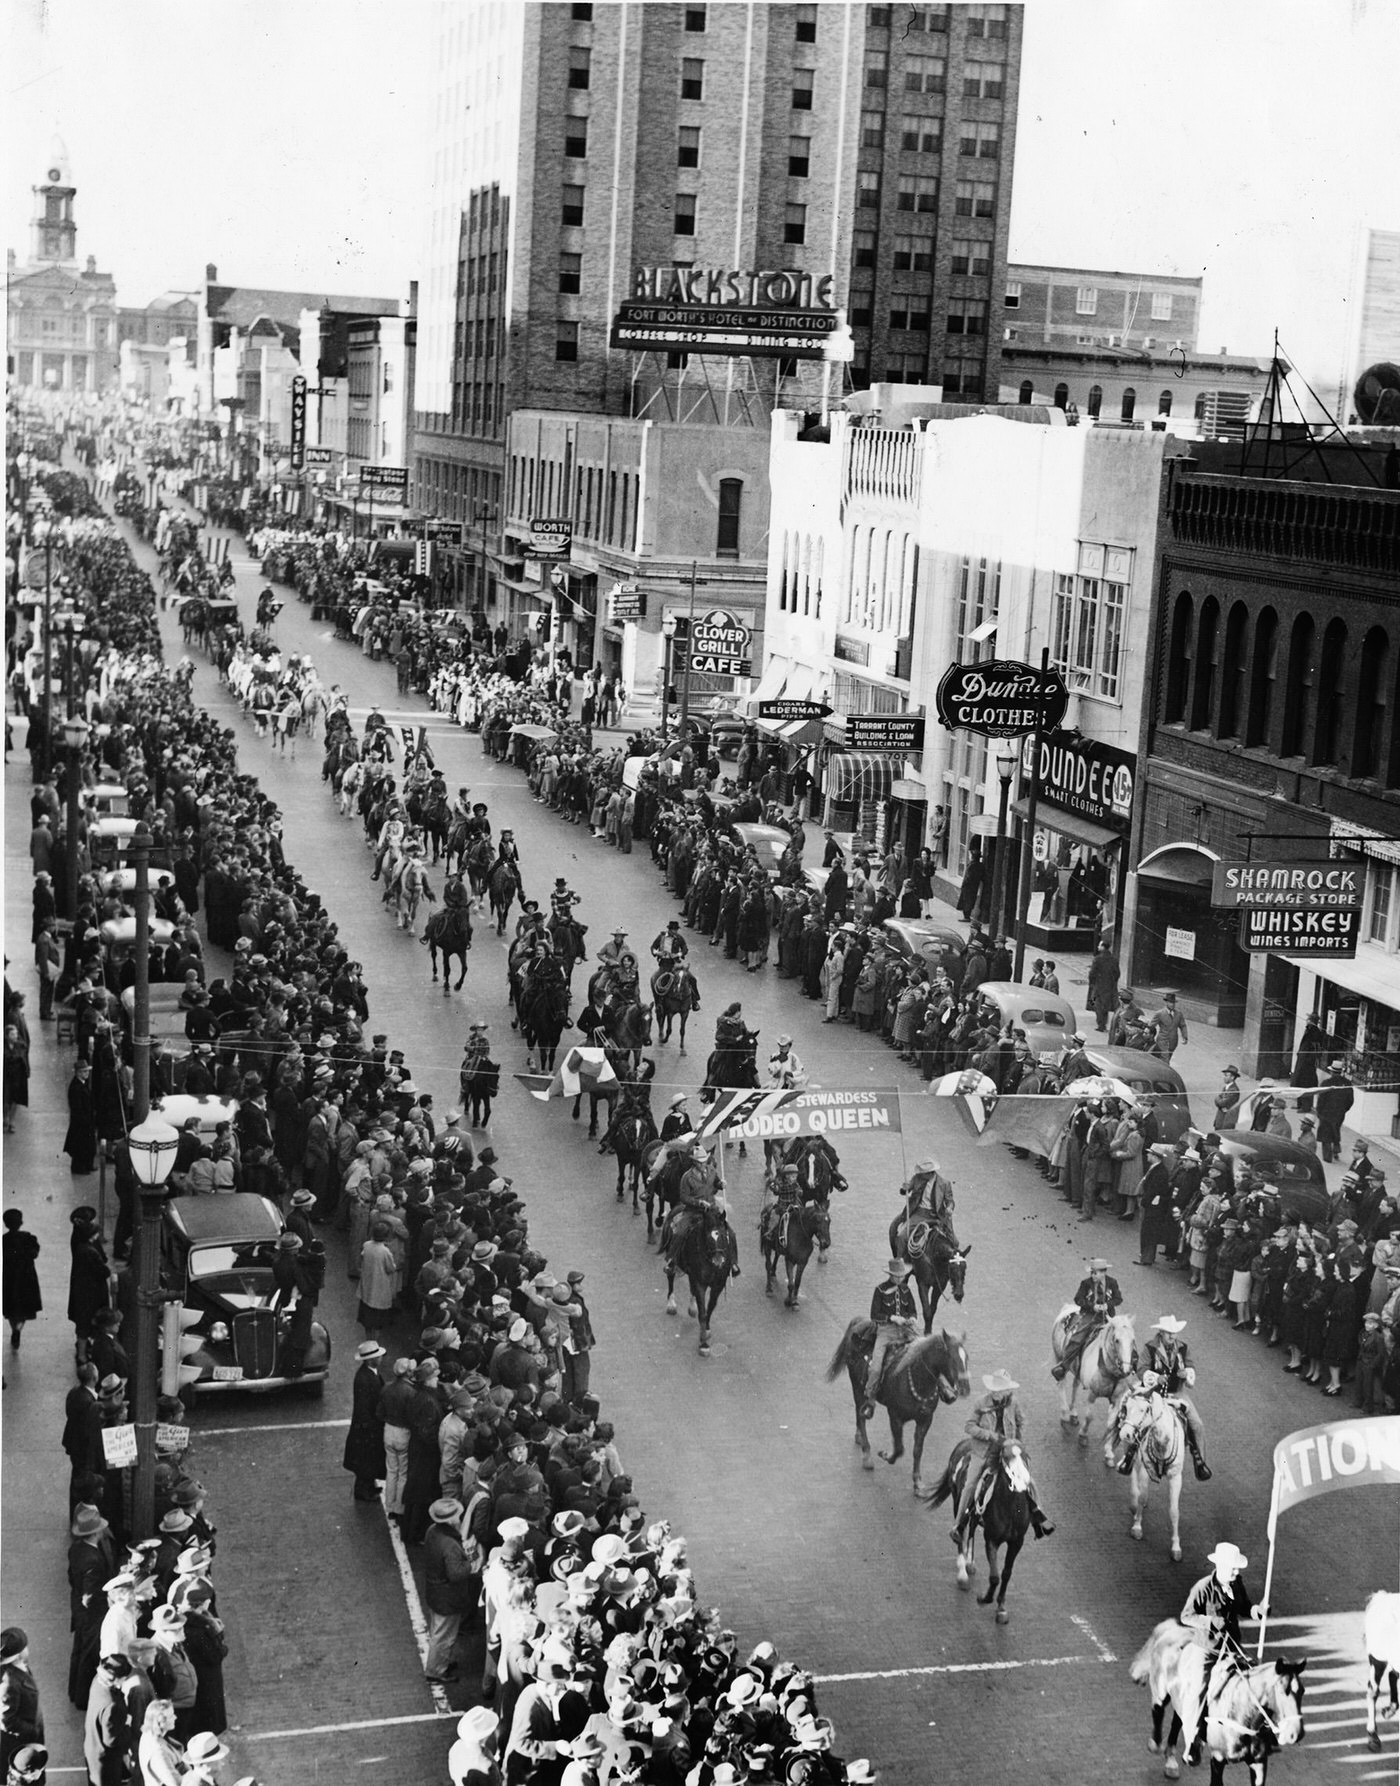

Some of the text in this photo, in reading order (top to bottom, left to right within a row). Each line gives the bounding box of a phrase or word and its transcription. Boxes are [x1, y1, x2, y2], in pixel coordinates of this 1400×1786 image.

[635, 266, 833, 308] BLACKSTONE
[628, 309, 655, 320] FORT
[658, 311, 705, 323] WORTH'S
[709, 313, 744, 326] HOTEL
[760, 315, 837, 329] DISTINCTION
[307, 450, 330, 461] INN
[534, 523, 570, 532] WORTH
[694, 626, 744, 642] CLOVER
[697, 640, 739, 655] GRILL
[692, 656, 742, 674] CAFE
[763, 706, 821, 714] LEDERMAN
[958, 706, 1047, 726] CLOTHES
[854, 721, 916, 731] TARRANT COUNTY
[854, 731, 887, 740] BUILDING
[895, 732, 915, 740] LOAN
[1039, 741, 1115, 807] DUNDEE
[1044, 785, 1069, 804] SMART
[1071, 795, 1104, 818] CLOTHES
[1225, 868, 1356, 891] SHAMROCK
[1236, 892, 1356, 905] PACKAGE STORE
[1250, 911, 1353, 933] WHISKEY
[1250, 935, 1349, 948] WINES IMPORTS
[796, 1091, 877, 1108] STEWARDESS
[808, 1108, 890, 1134] QUEEN
